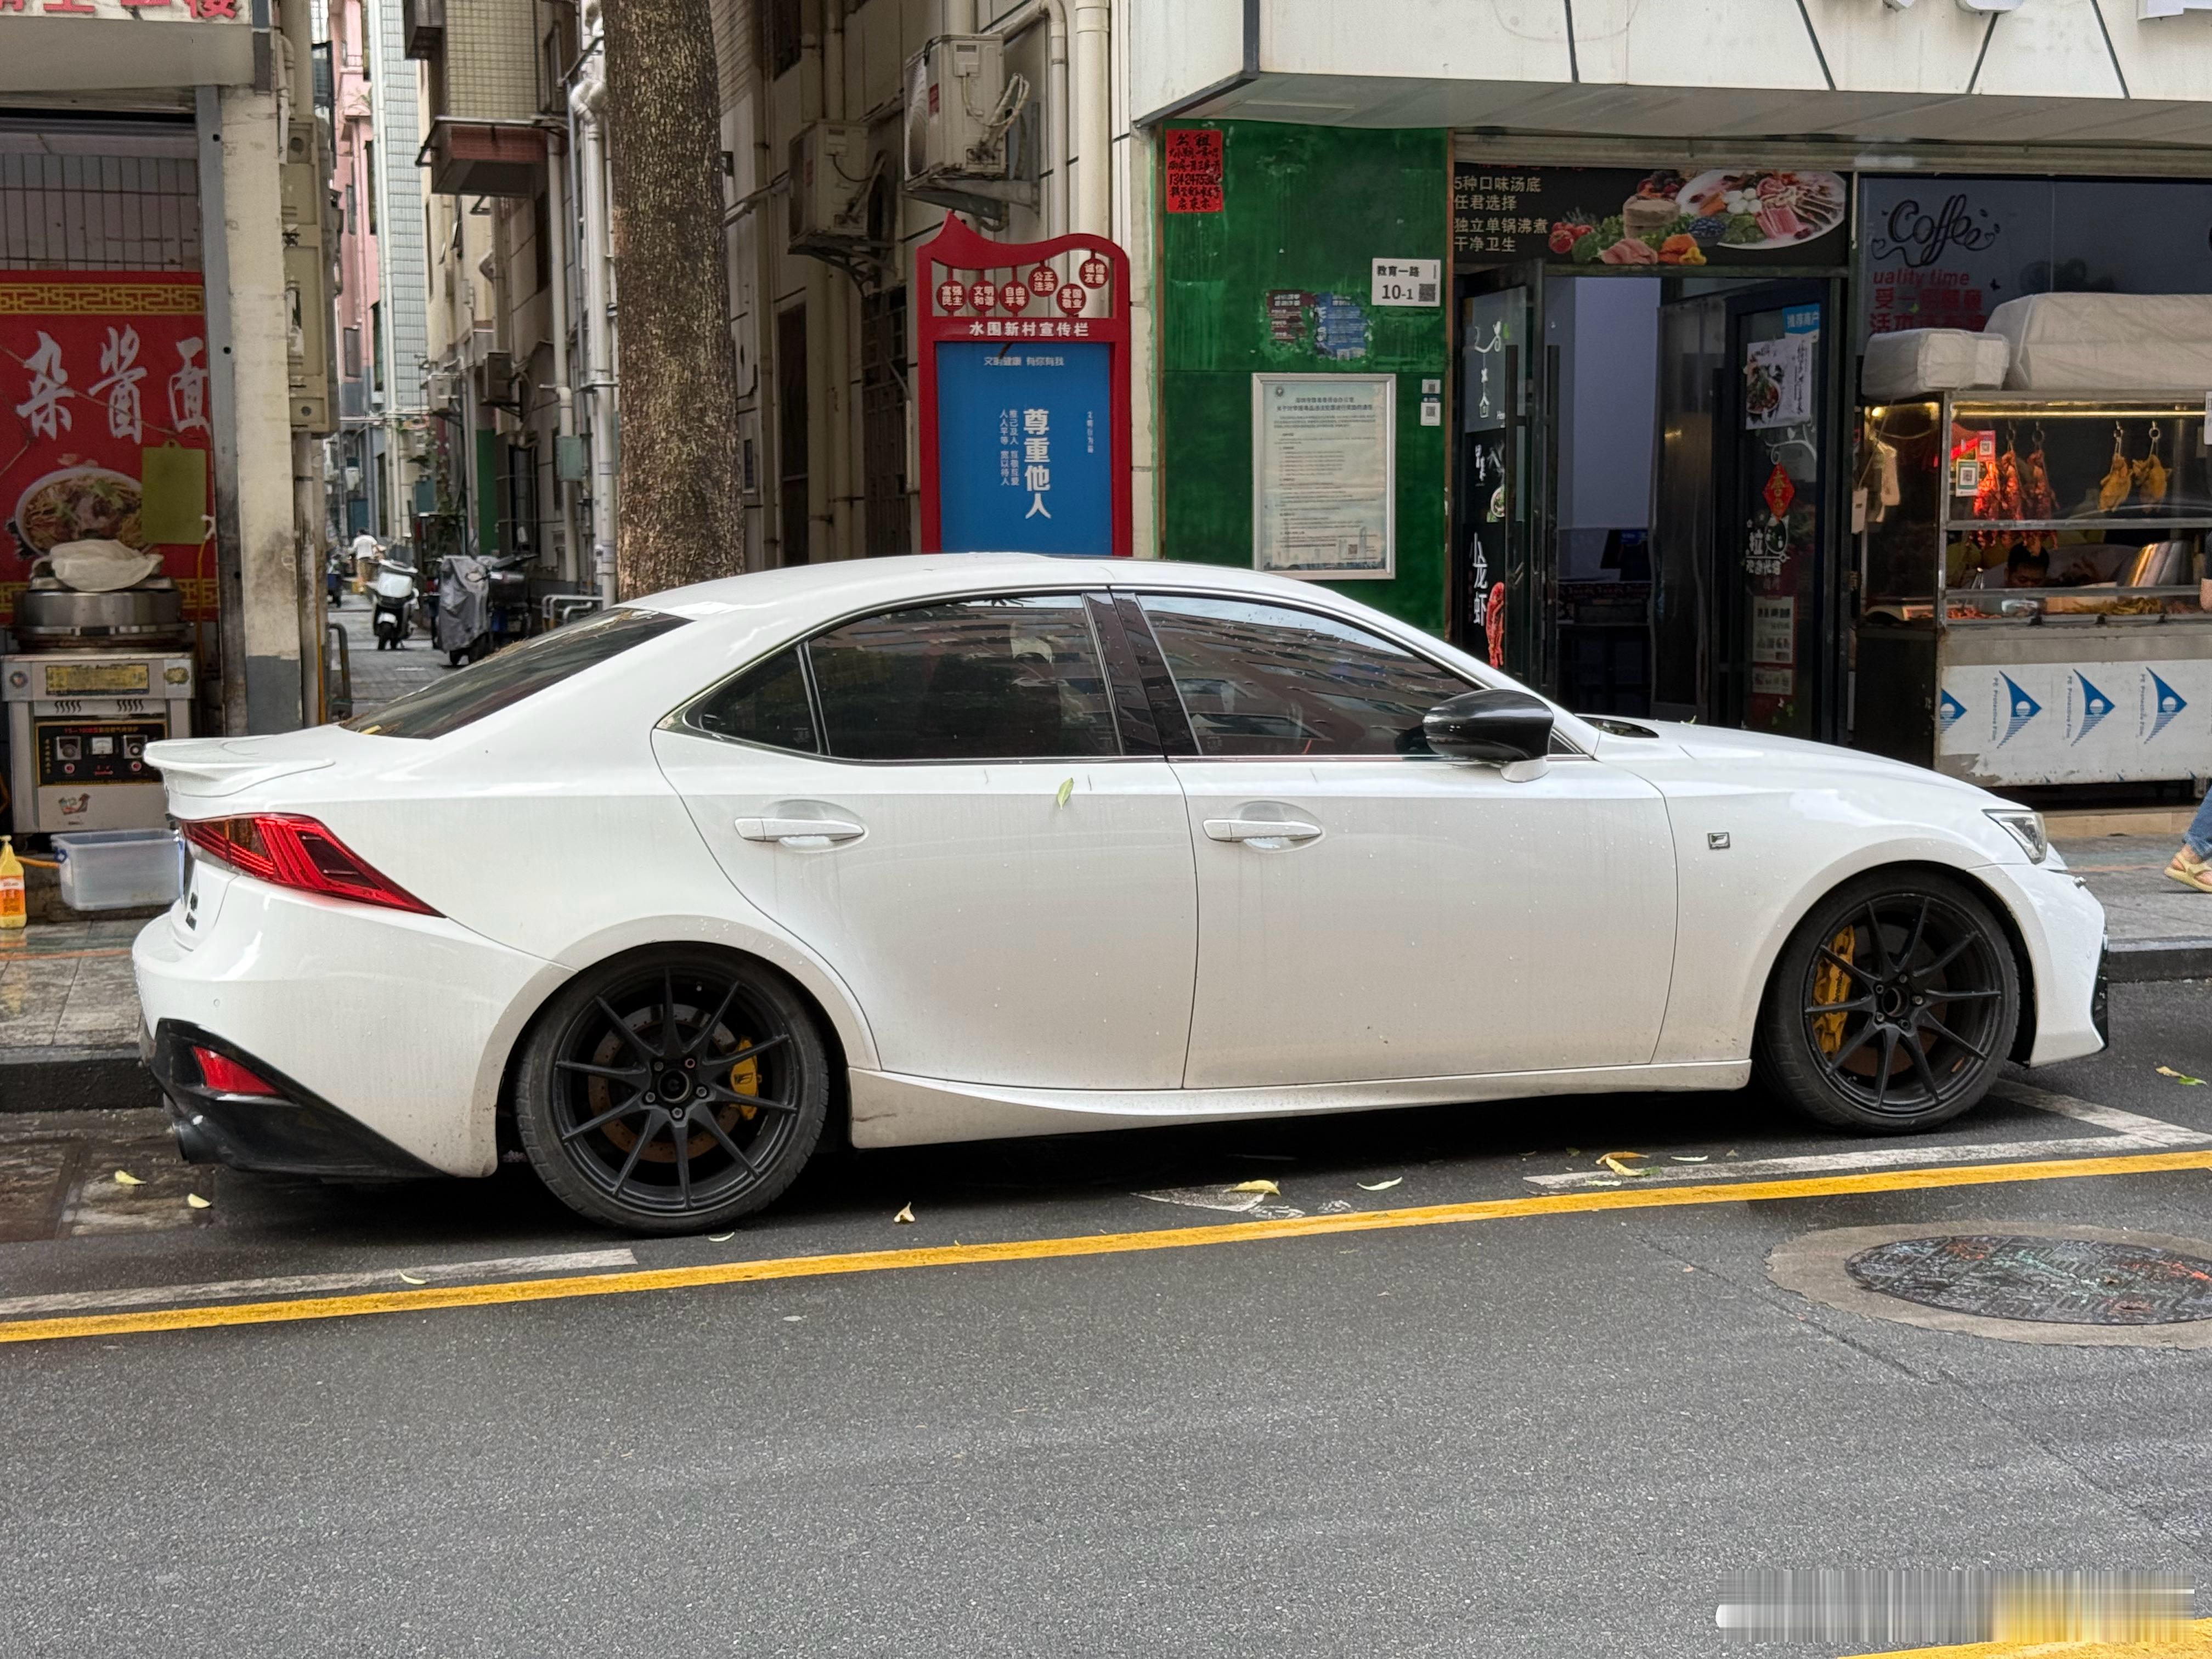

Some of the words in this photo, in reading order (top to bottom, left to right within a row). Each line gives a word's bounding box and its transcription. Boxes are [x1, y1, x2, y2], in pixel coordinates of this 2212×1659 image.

[1454, 176, 1542, 193] 5种口味汤底
[1454, 194, 1518, 211] 任君选择
[1454, 217, 1549, 234] 独立单锅沸煮
[1879, 194, 1987, 267] Coffee
[1454, 236, 1517, 252] 干净卫生
[1033, 271, 1054, 281] 公正
[1377, 265, 1420, 277] 教育一路
[941, 286, 963, 296] 富强
[973, 286, 995, 296] 文明
[1005, 286, 1026, 296] 自由
[1034, 281, 1054, 292] 法治
[1062, 289, 1082, 298] 爱国
[1381, 284, 1414, 300] 10-1
[941, 296, 963, 306] 民主
[1005, 296, 1026, 307] 平等
[969, 321, 1089, 337] 水围新村宣传栏
[15, 324, 212, 444] 杂酱面
[1023, 409, 1052, 519] 尊重他人
[1469, 532, 1488, 627] 小龙虾
